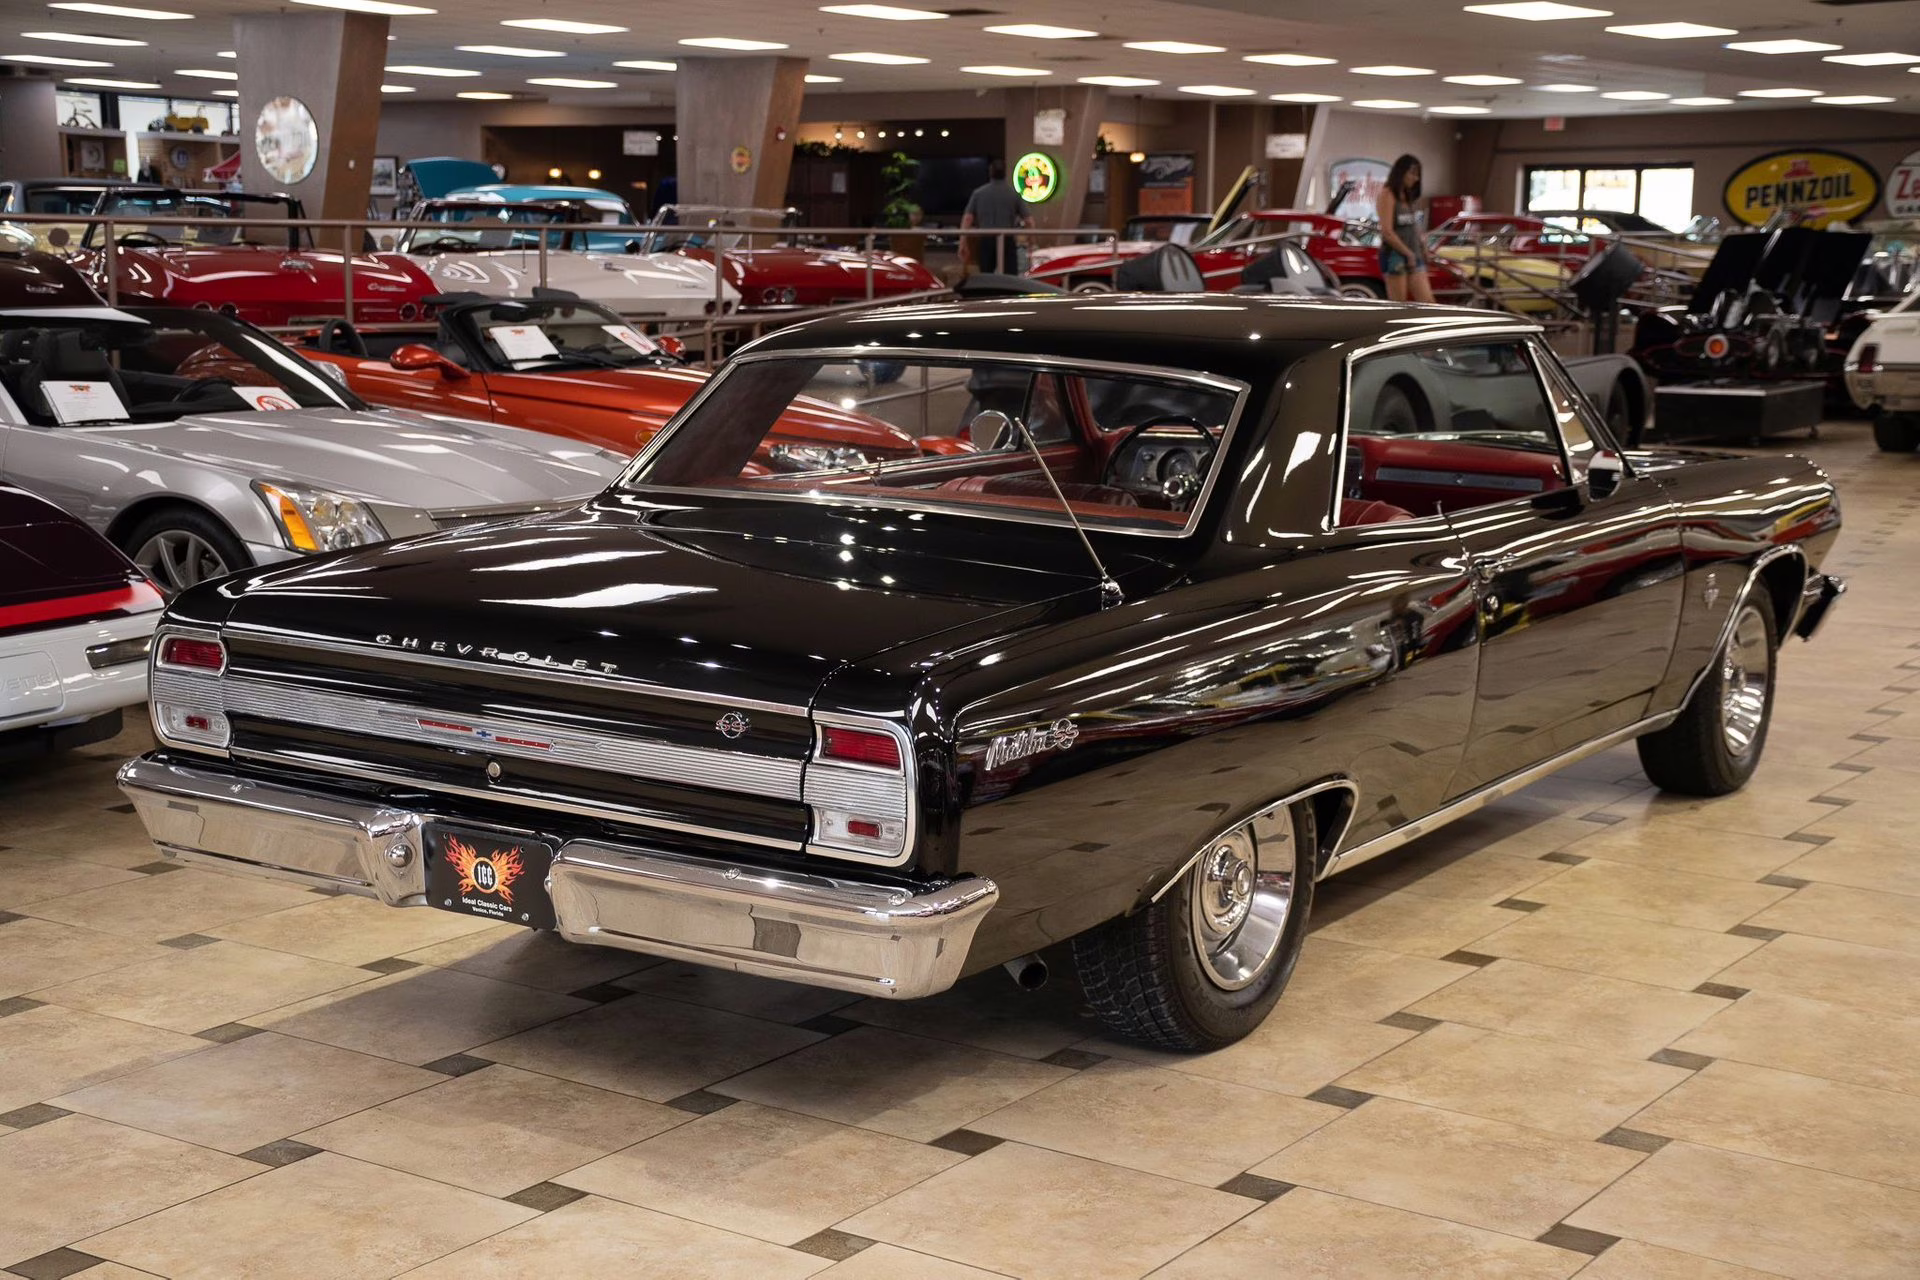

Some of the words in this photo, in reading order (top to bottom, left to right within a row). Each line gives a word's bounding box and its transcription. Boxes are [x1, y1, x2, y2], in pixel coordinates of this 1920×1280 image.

[1745, 173, 1856, 210] PENNZOIL
[376, 634, 619, 673] CHEVROLET
[985, 727, 1057, 770] Malibu
[462, 896, 477, 905] Ideal
[477, 899, 498, 909] Classic
[498, 903, 513, 913] Cars
